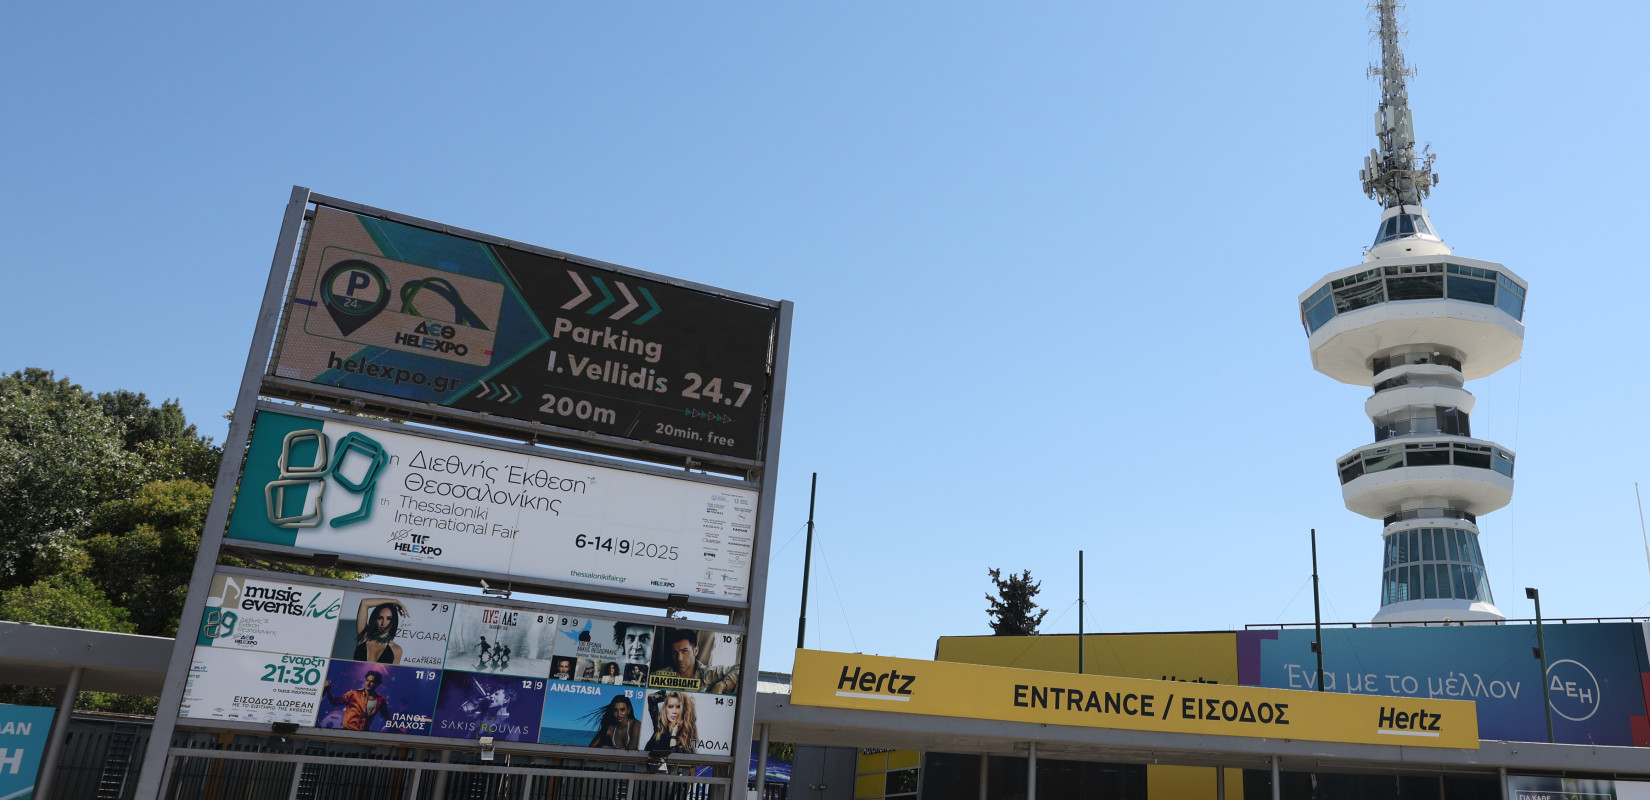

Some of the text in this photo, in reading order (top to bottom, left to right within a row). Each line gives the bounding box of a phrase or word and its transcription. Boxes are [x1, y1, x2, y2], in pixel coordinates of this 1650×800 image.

[346, 270, 370, 296] P
[414, 321, 456, 340] ΔΕΘ
[552, 317, 662, 363] Parking
[394, 332, 468, 356] HELEXPO
[328, 351, 462, 393] helexpo.gr
[681, 372, 752, 408] 24.7
[539, 393, 616, 425] 200m
[655, 422, 735, 447] 20min. free
[408, 450, 499, 484] Διεθνής
[505, 464, 586, 494] Έκθεση
[404, 472, 562, 517] Θεσσαλονίκης
[400, 494, 489, 520] Thessaloniki
[395, 510, 488, 536] International
[492, 524, 520, 539] Fair
[394, 542, 442, 556] HELEXPO
[411, 534, 430, 544] TIF
[570, 570, 626, 583] thessalonikifair.gr
[650, 580, 675, 588] HELEXPO
[242, 592, 341, 619] events live
[244, 586, 302, 602] music
[395, 629, 447, 642] ZEVGARA
[281, 653, 325, 668] έναρξη
[403, 657, 442, 665] ALCATRASH
[260, 664, 321, 686] 21:30
[651, 676, 699, 688] ΙΑΚΩΒΙΔΗΣ
[837, 665, 915, 695] Hertz
[1284, 664, 1521, 699] Ένα με το μέλλον
[550, 682, 602, 696] ANASTASIA
[1550, 675, 1593, 704] ΔΕΗ
[234, 696, 314, 709] ΕΙΣΟΔΟΣ ΔΩΡΕΑΝ
[1013, 684, 1290, 725] ENTRANCE / ΕΙΣΟΔΟΣ
[385, 721, 426, 730] ΒΛΑΧΟΣ
[392, 713, 427, 722] ΠΑΝΟΣ
[441, 720, 529, 734] SAKIS ROUVAS
[1378, 706, 1441, 731] Hertz
[689, 739, 729, 751] ΠΑΟΛΑ
